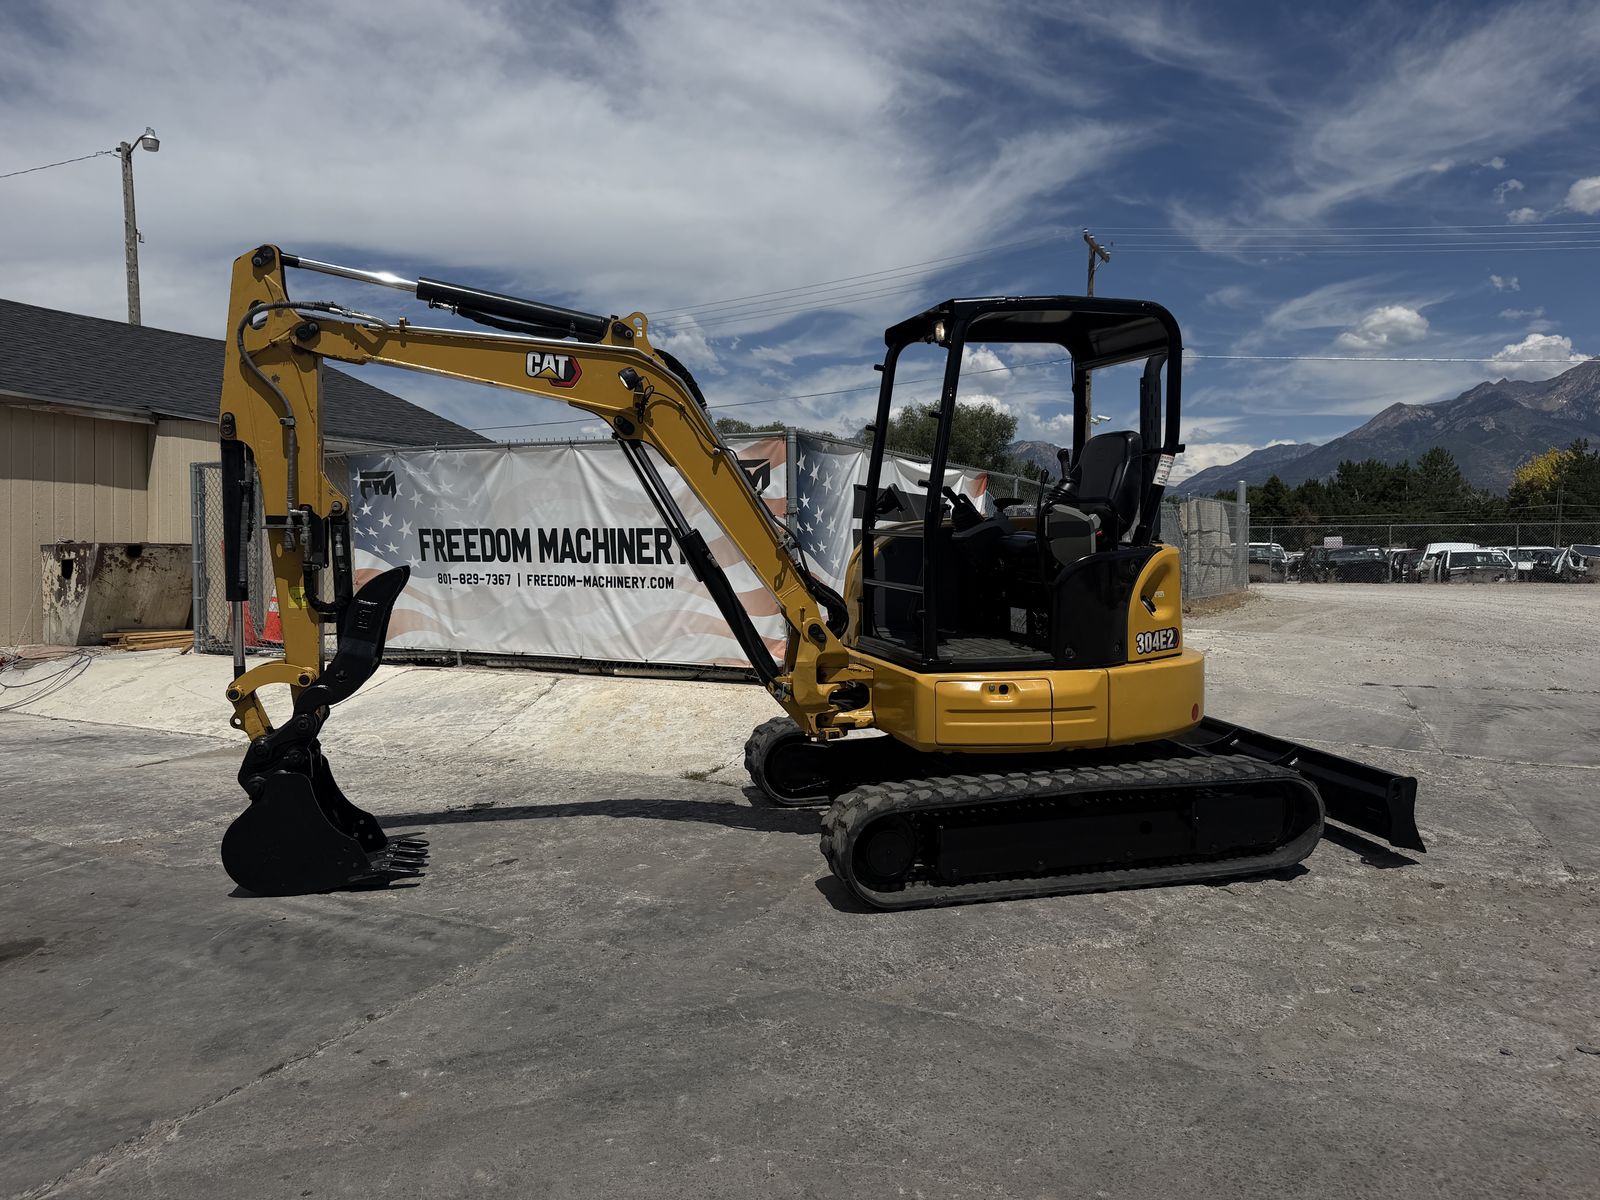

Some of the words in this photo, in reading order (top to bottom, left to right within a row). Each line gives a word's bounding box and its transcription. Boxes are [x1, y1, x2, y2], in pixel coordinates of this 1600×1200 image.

[526, 351, 569, 380] CAT
[418, 528, 532, 563] FREEDOM
[437, 573, 511, 586] 801-829-7367
[527, 574, 674, 590] FREEDOM-MACHINERY.COM
[1136, 629, 1175, 654] 304E2
